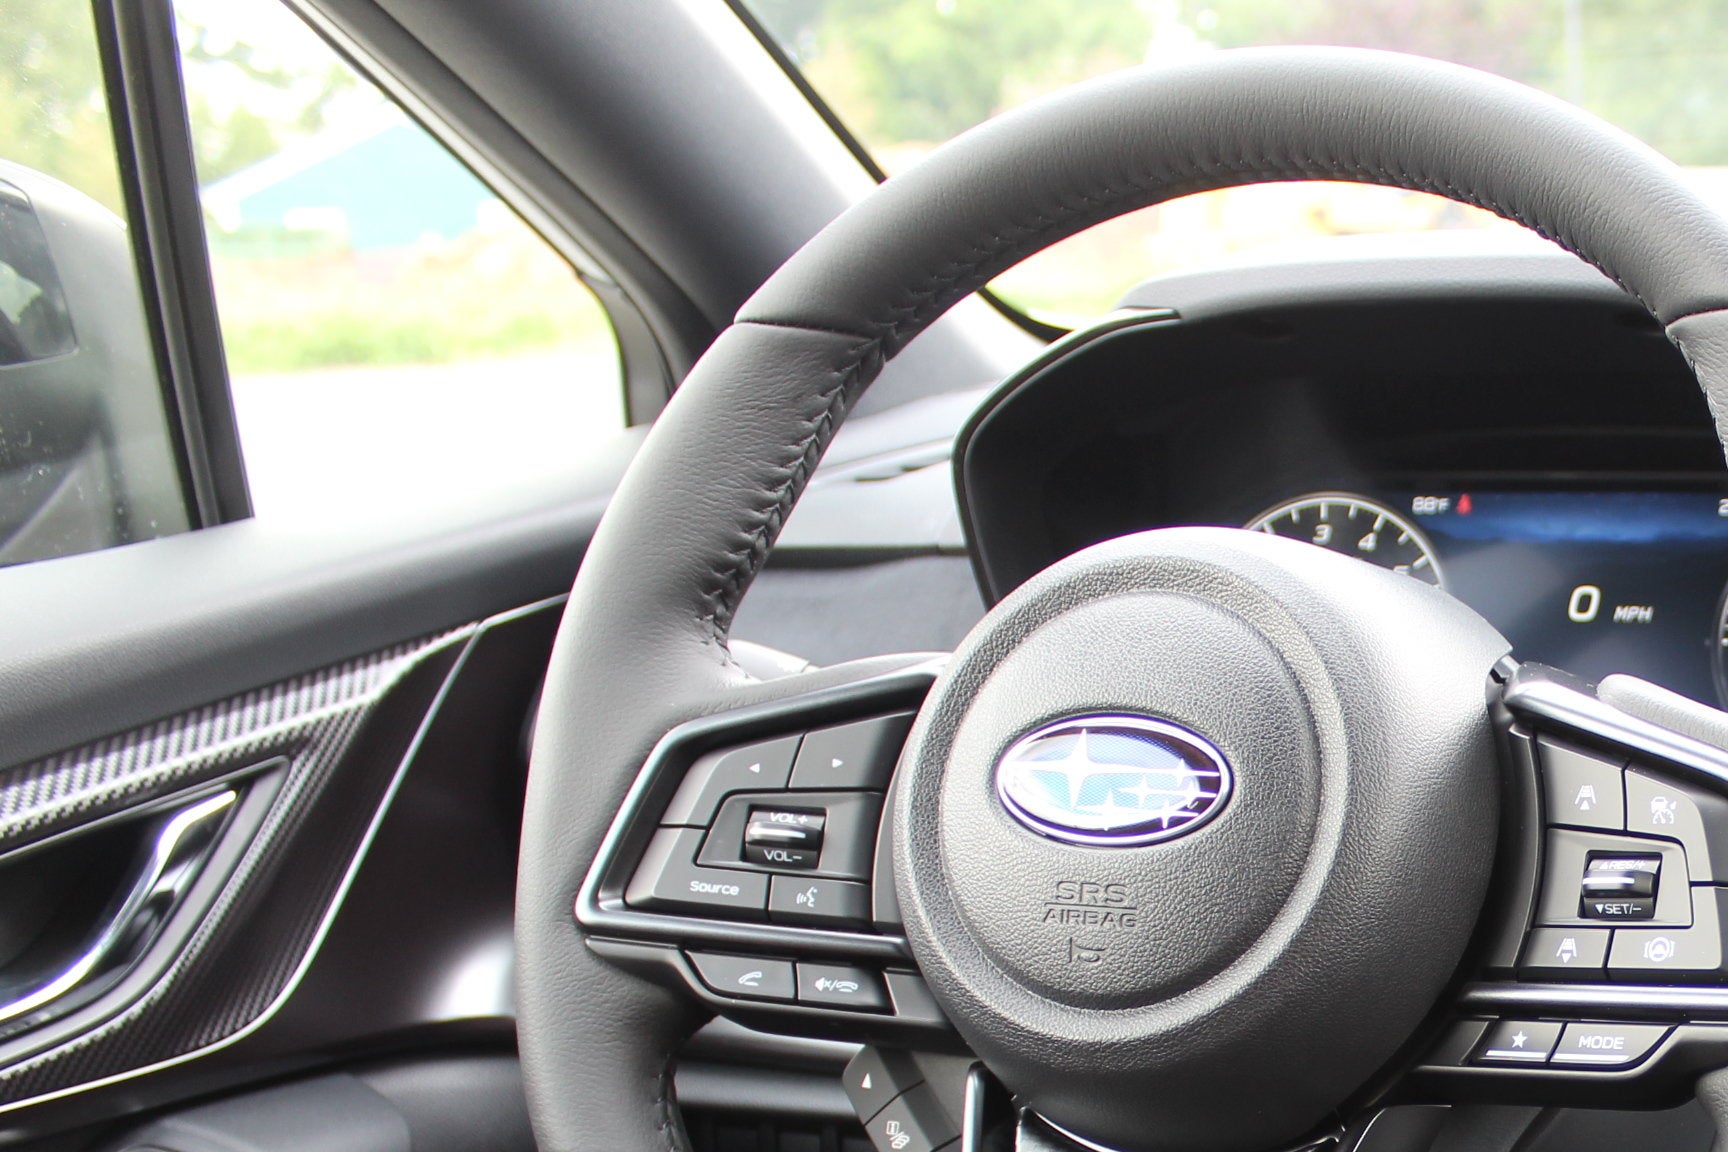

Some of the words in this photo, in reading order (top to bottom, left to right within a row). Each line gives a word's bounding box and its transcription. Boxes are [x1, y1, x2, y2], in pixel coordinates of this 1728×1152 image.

[1313, 524, 1333, 544] 3
[1358, 532, 1377, 551] 4
[1568, 585, 1601, 623] 0
[1613, 605, 1653, 622] MPH
[689, 880, 739, 895] Source
[1056, 881, 1128, 903] SRS
[1043, 908, 1137, 928] AIRBAG
[1579, 1035, 1624, 1050] MODE
